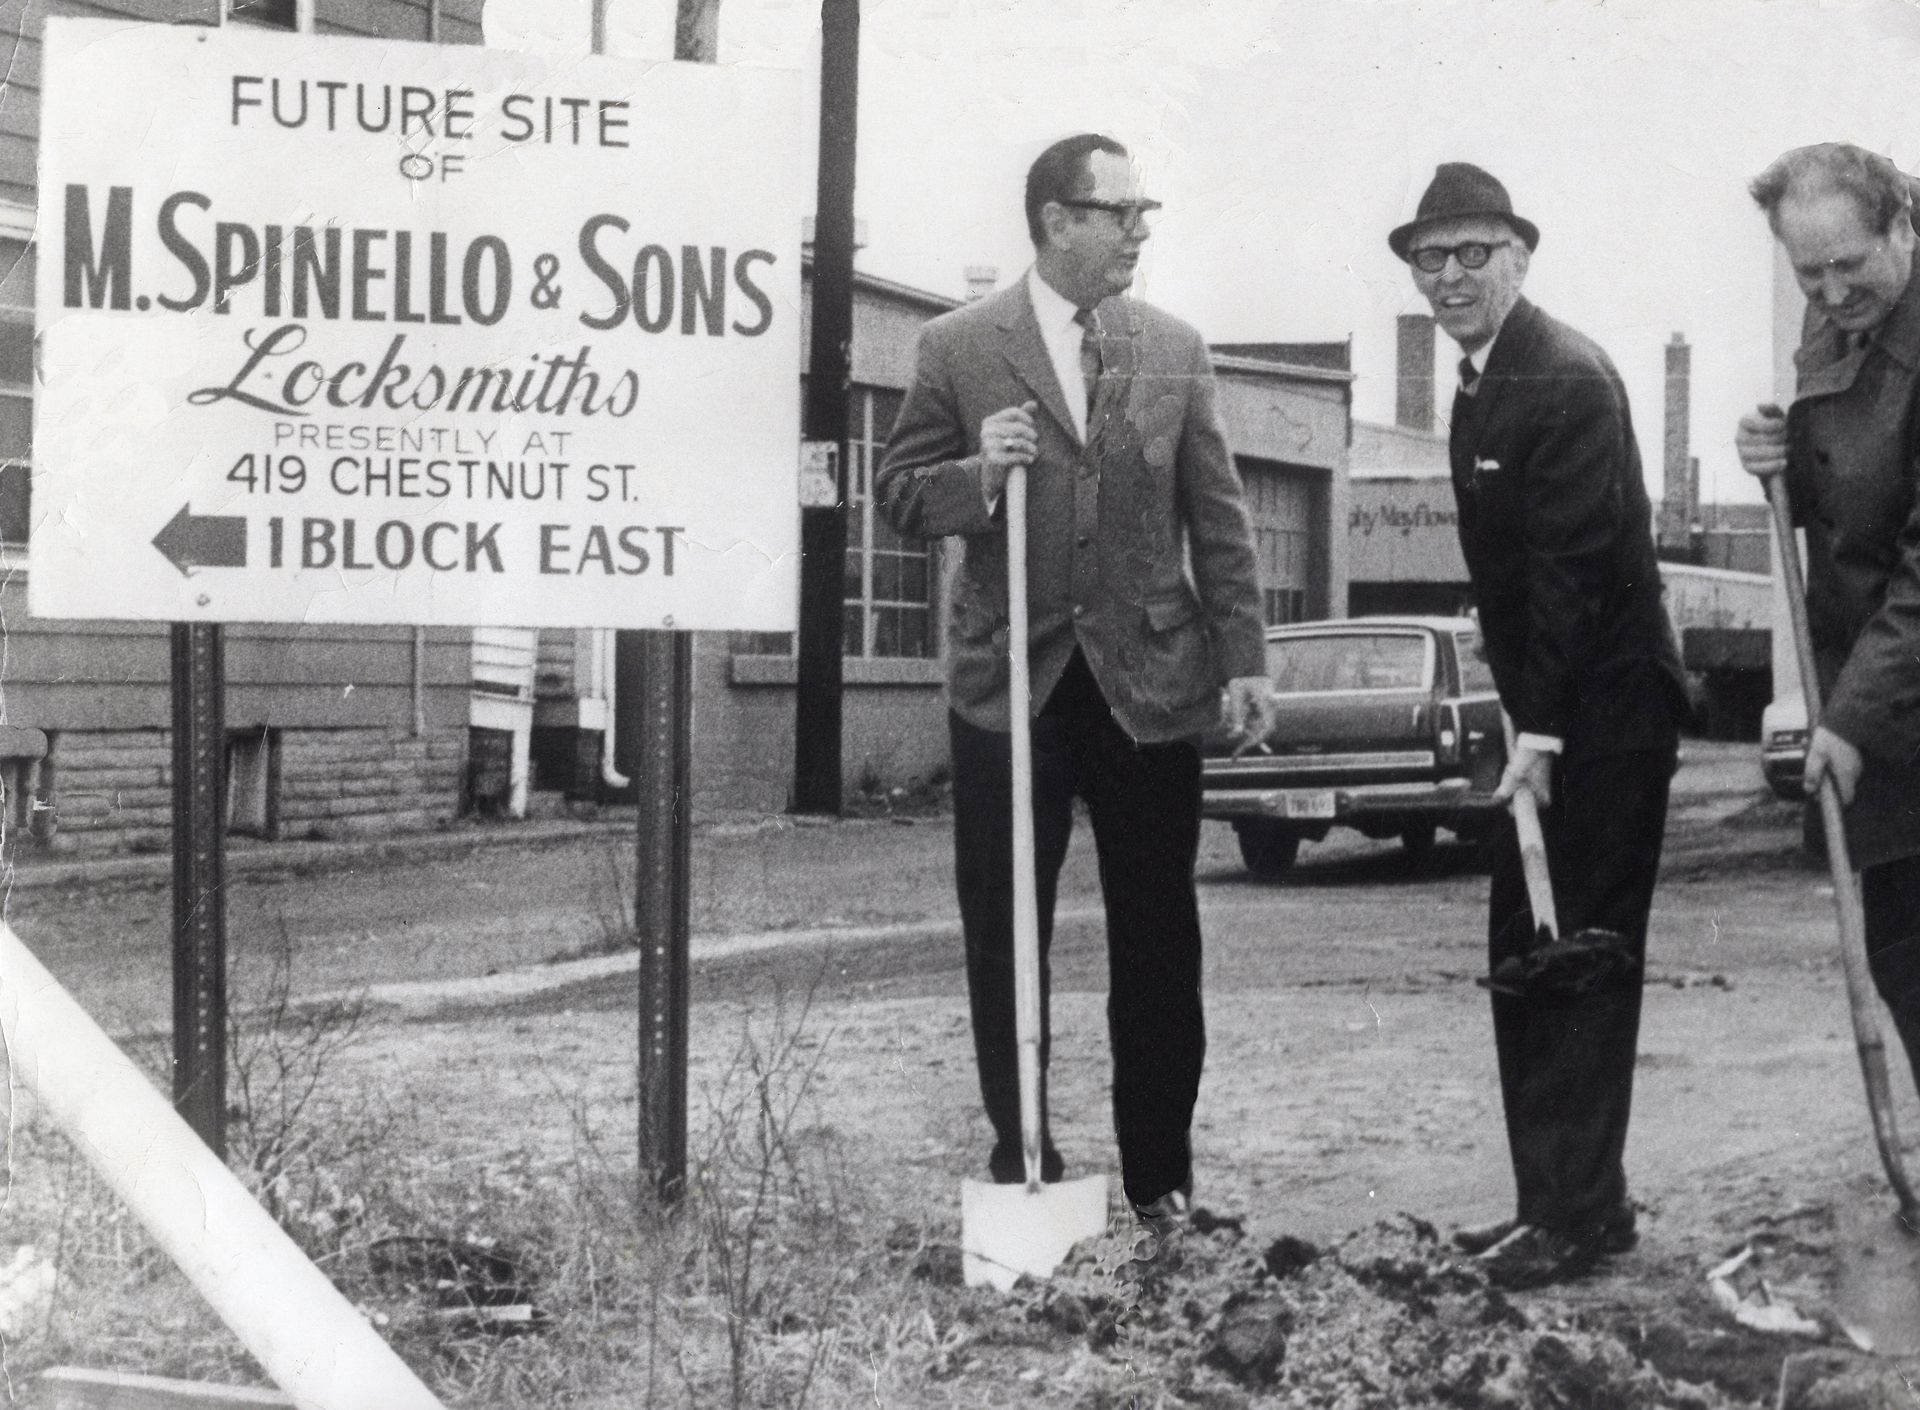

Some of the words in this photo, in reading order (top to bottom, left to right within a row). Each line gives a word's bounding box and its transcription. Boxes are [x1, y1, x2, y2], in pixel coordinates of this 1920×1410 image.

[231, 74, 475, 140] FUTURE
[500, 93, 630, 148] SITE
[399, 153, 465, 183] OF
[530, 253, 563, 310] &
[578, 213, 777, 338] SONS
[186, 323, 640, 419] Locksmiths
[273, 422, 498, 455] PRESENTLY
[523, 431, 572, 456] AT
[226, 453, 307, 495] 419
[329, 456, 570, 502] CHESTNUT
[586, 464, 640, 503] ST.
[267, 516, 284, 569] 1
[300, 516, 506, 574] BLOCK
[539, 523, 686, 577] EAST
